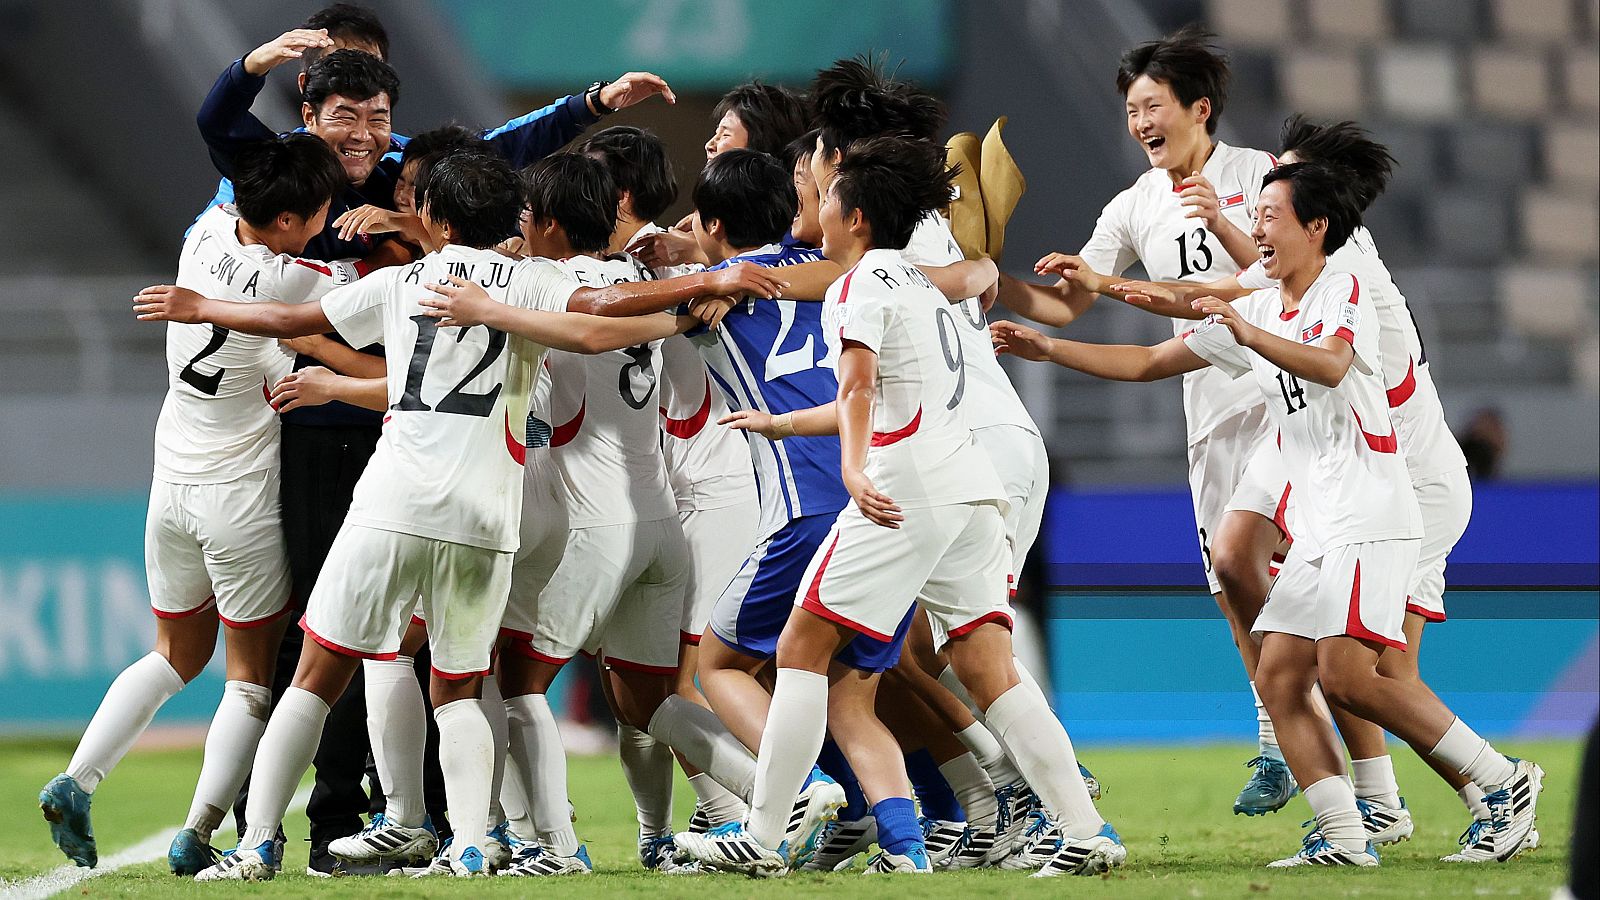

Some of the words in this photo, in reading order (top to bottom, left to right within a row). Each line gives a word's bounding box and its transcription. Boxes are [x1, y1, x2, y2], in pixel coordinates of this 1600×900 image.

[210, 252, 243, 286] JIN
[242, 270, 260, 297] A
[439, 262, 475, 288] JIN
[481, 262, 514, 288] JU
[1174, 227, 1213, 280] 13
[180, 325, 230, 397] 2
[390, 314, 508, 418] 12
[936, 307, 965, 410] 9
[1276, 369, 1307, 415] 14
